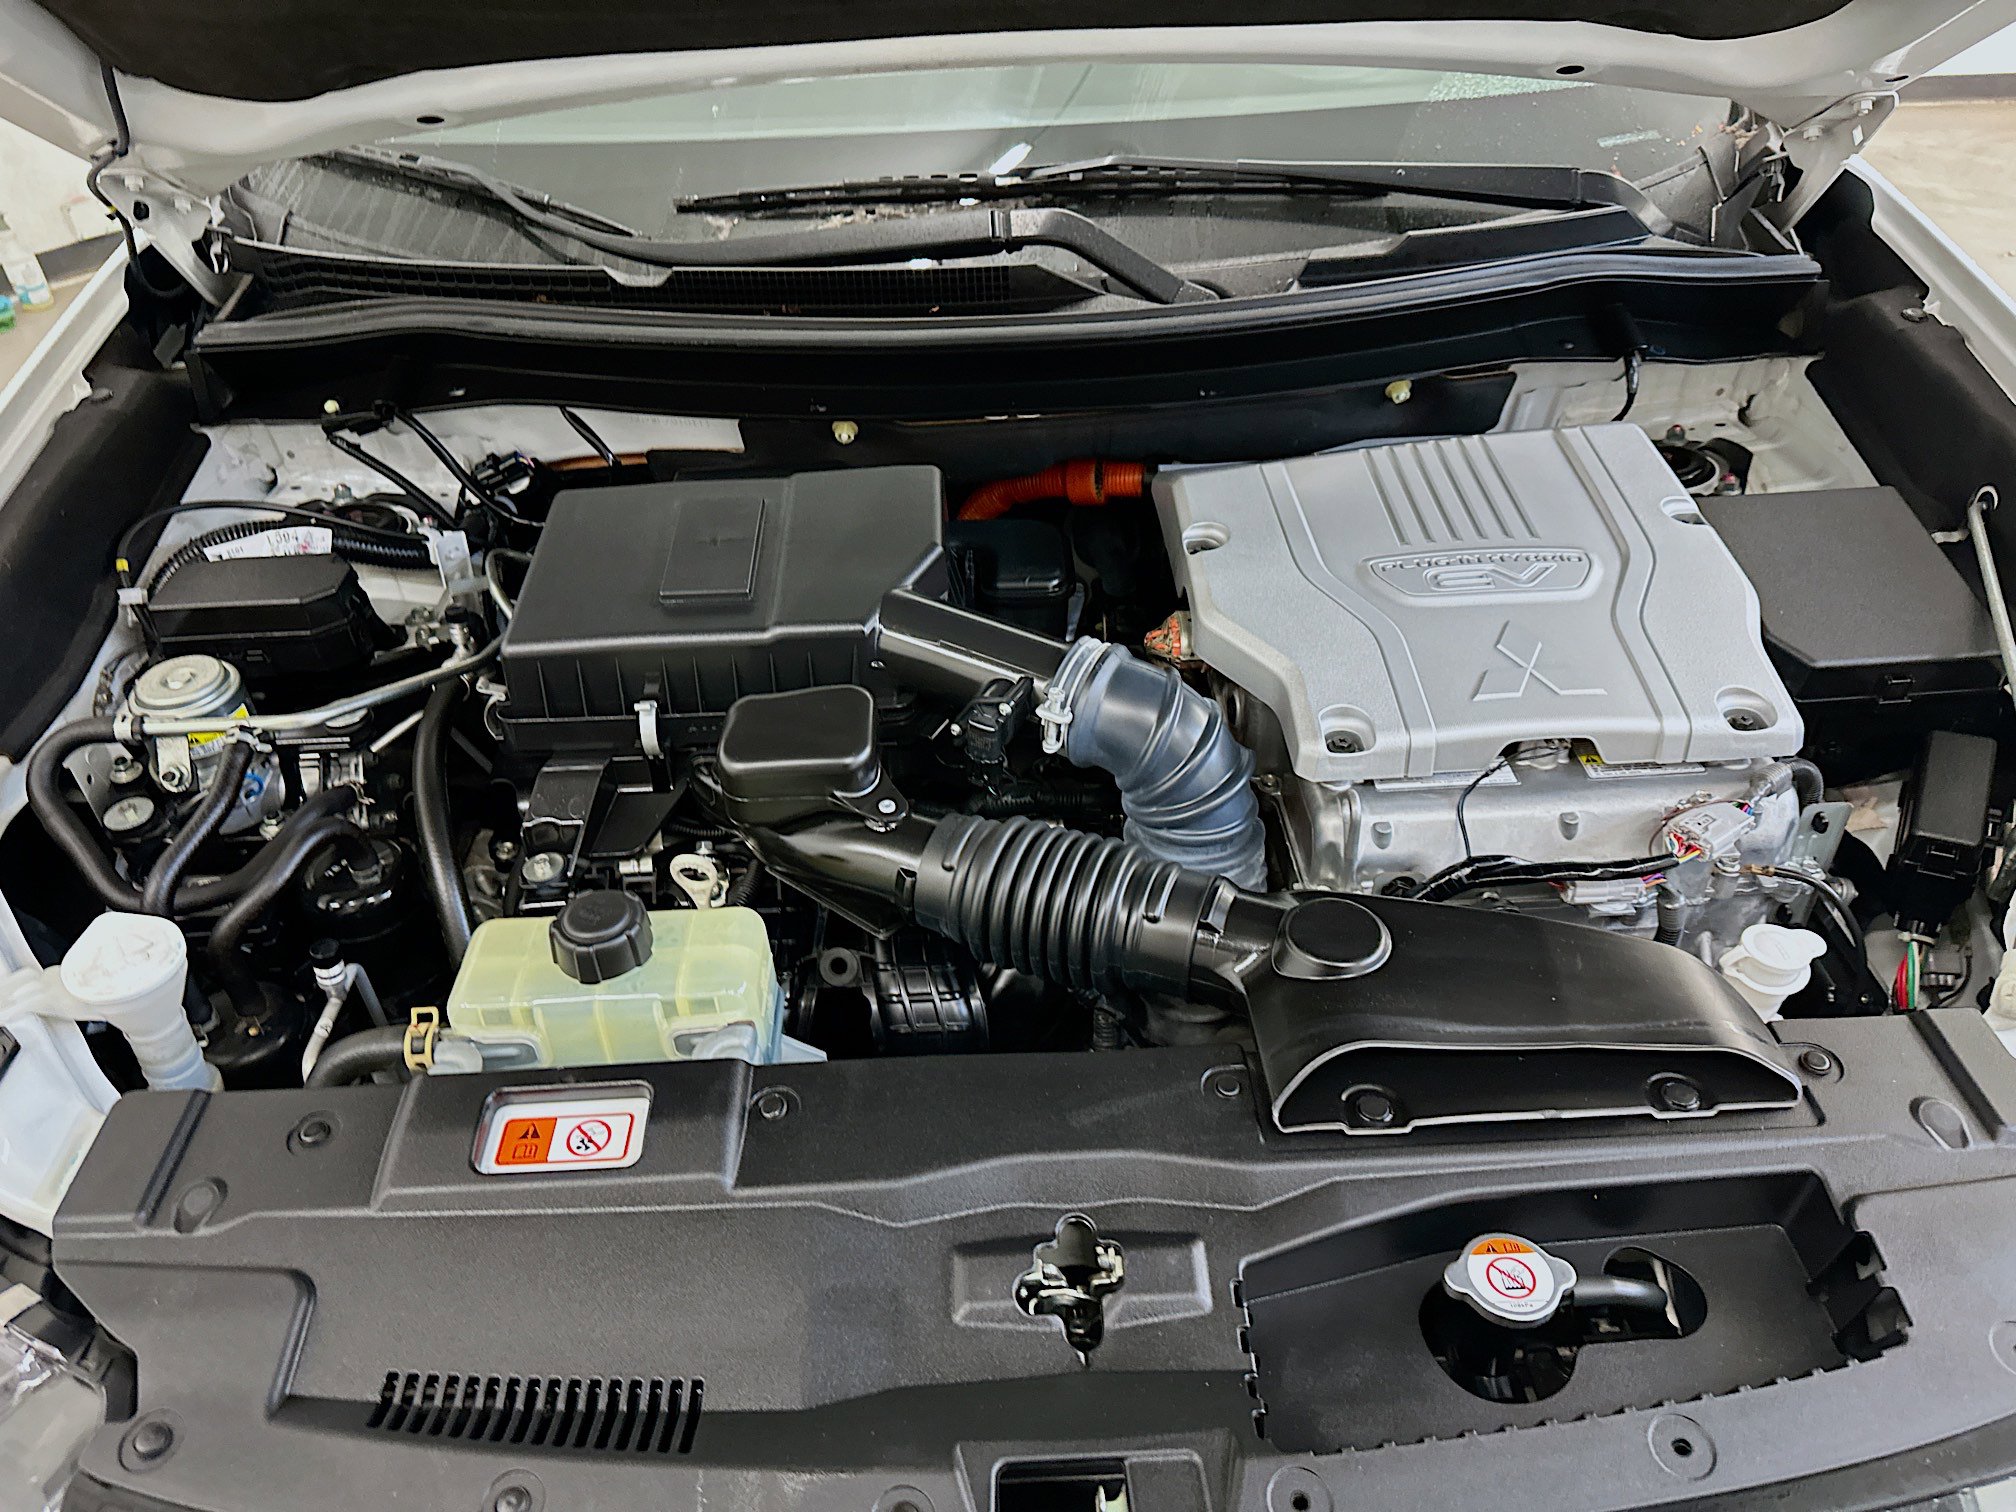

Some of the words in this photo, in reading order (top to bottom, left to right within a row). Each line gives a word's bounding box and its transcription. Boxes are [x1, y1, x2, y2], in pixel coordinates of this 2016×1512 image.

[1378, 554, 1483, 572] PLUG-IN
[1485, 552, 1583, 563] HYBRID
[1422, 562, 1558, 593] EV
